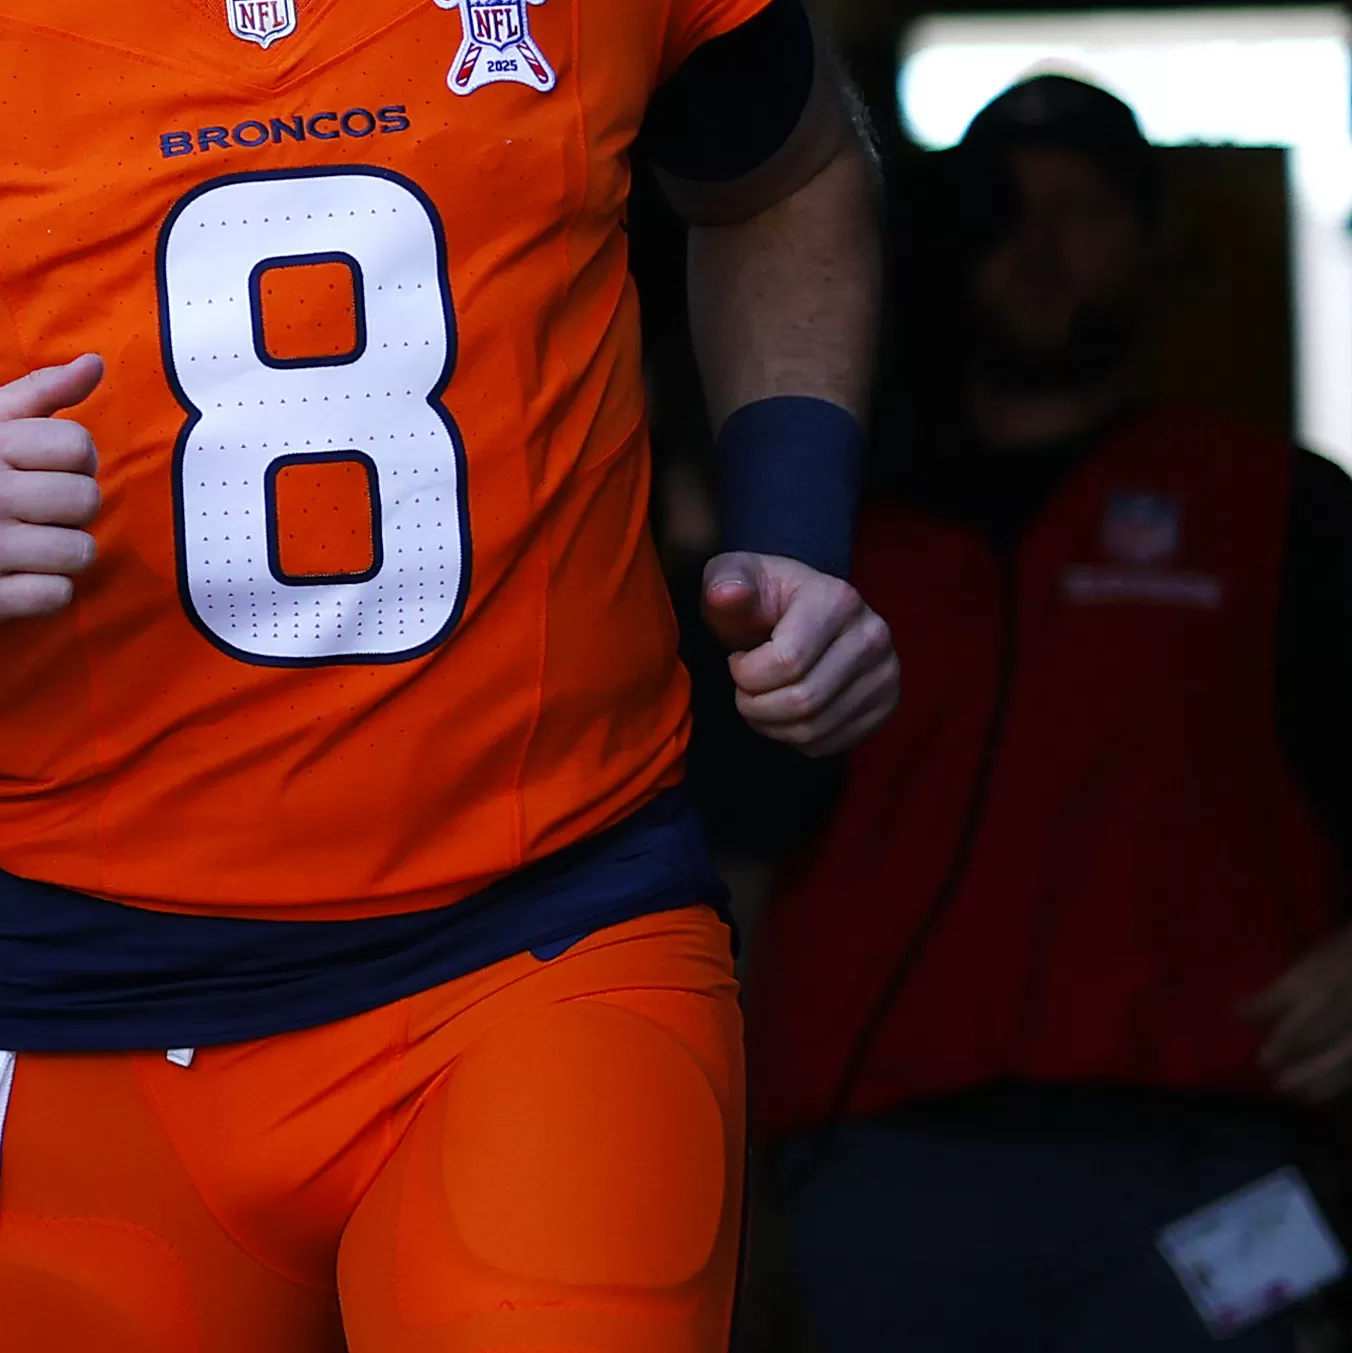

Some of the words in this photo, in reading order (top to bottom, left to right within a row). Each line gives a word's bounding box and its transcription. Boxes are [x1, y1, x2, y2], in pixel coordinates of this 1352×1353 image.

[238, 1, 285, 33] NFL
[473, 8, 519, 43] NFL
[486, 59, 519, 73] 2025
[159, 104, 411, 159] BRONCOS
[156, 164, 474, 667] 8
